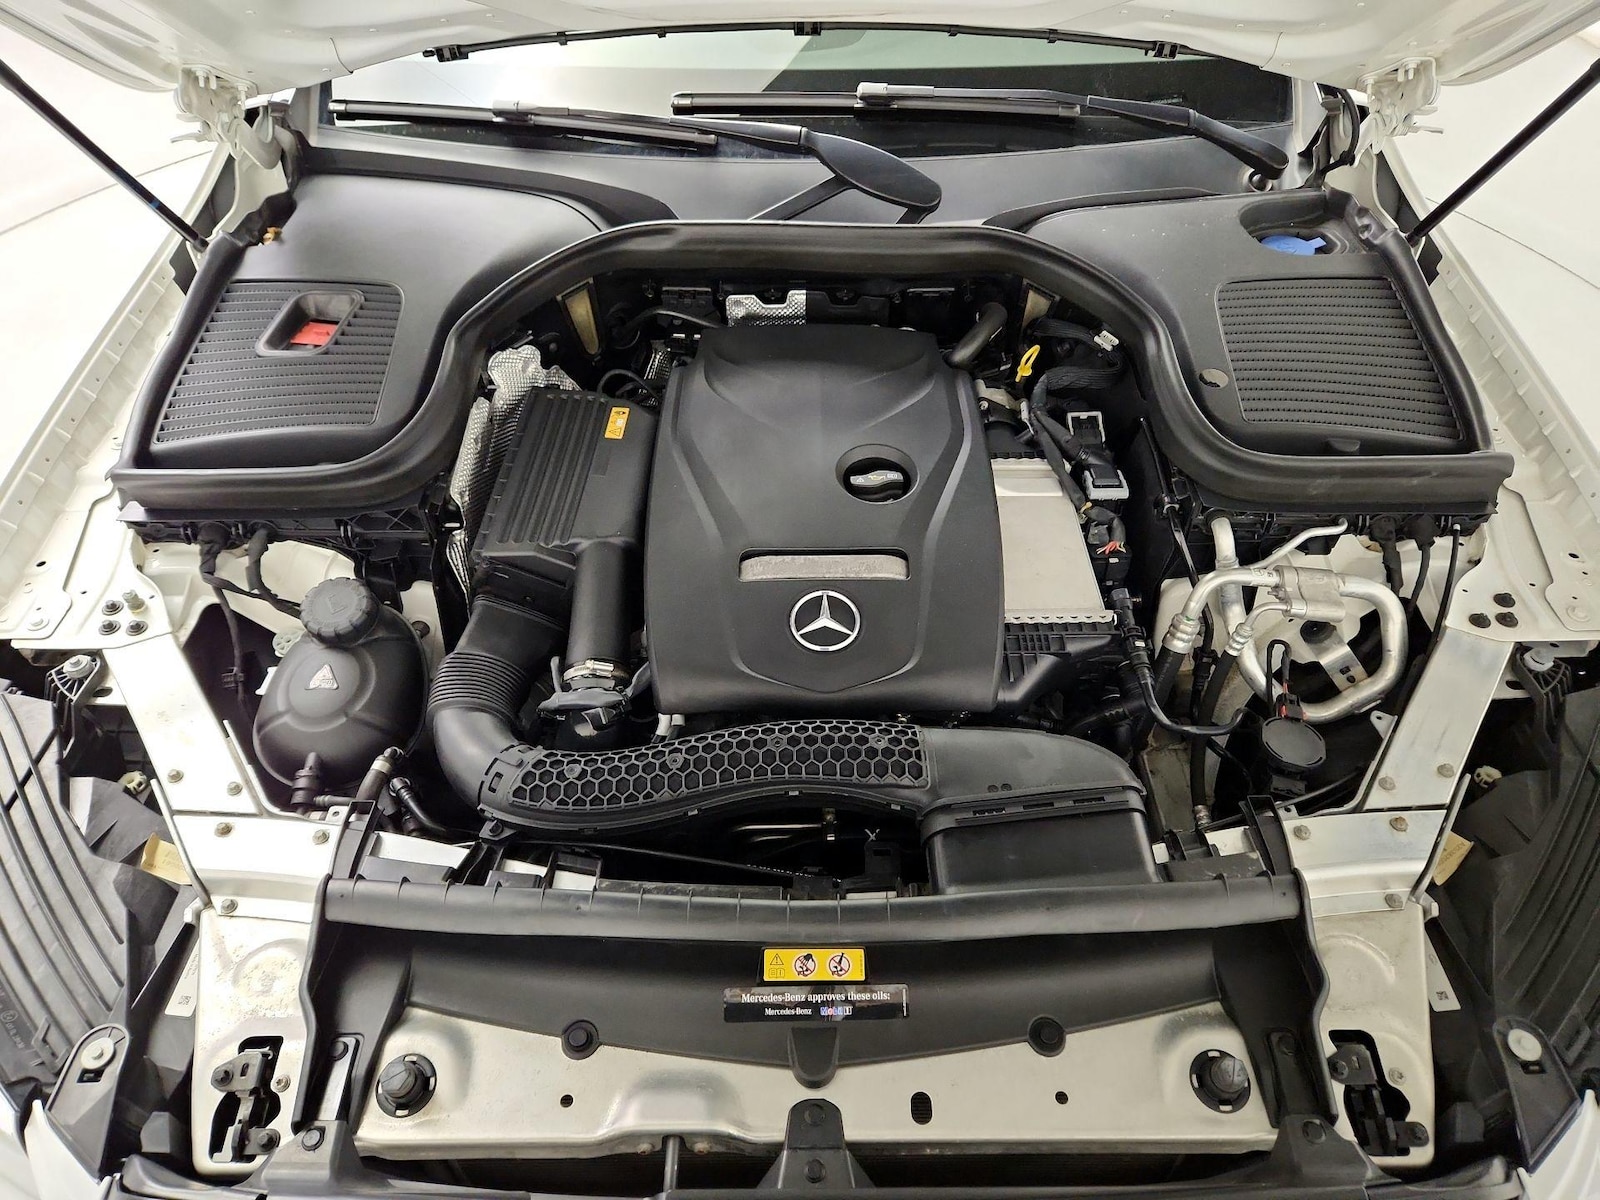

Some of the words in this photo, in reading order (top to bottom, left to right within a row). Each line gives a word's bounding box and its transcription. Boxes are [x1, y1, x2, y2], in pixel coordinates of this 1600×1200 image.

[741, 993, 806, 1003] Mercedes-Benz
[807, 991, 846, 1003] approves
[848, 991, 871, 1001] these
[872, 990, 891, 1001] oils:
[764, 1007, 812, 1016] Mercedes-Benz
